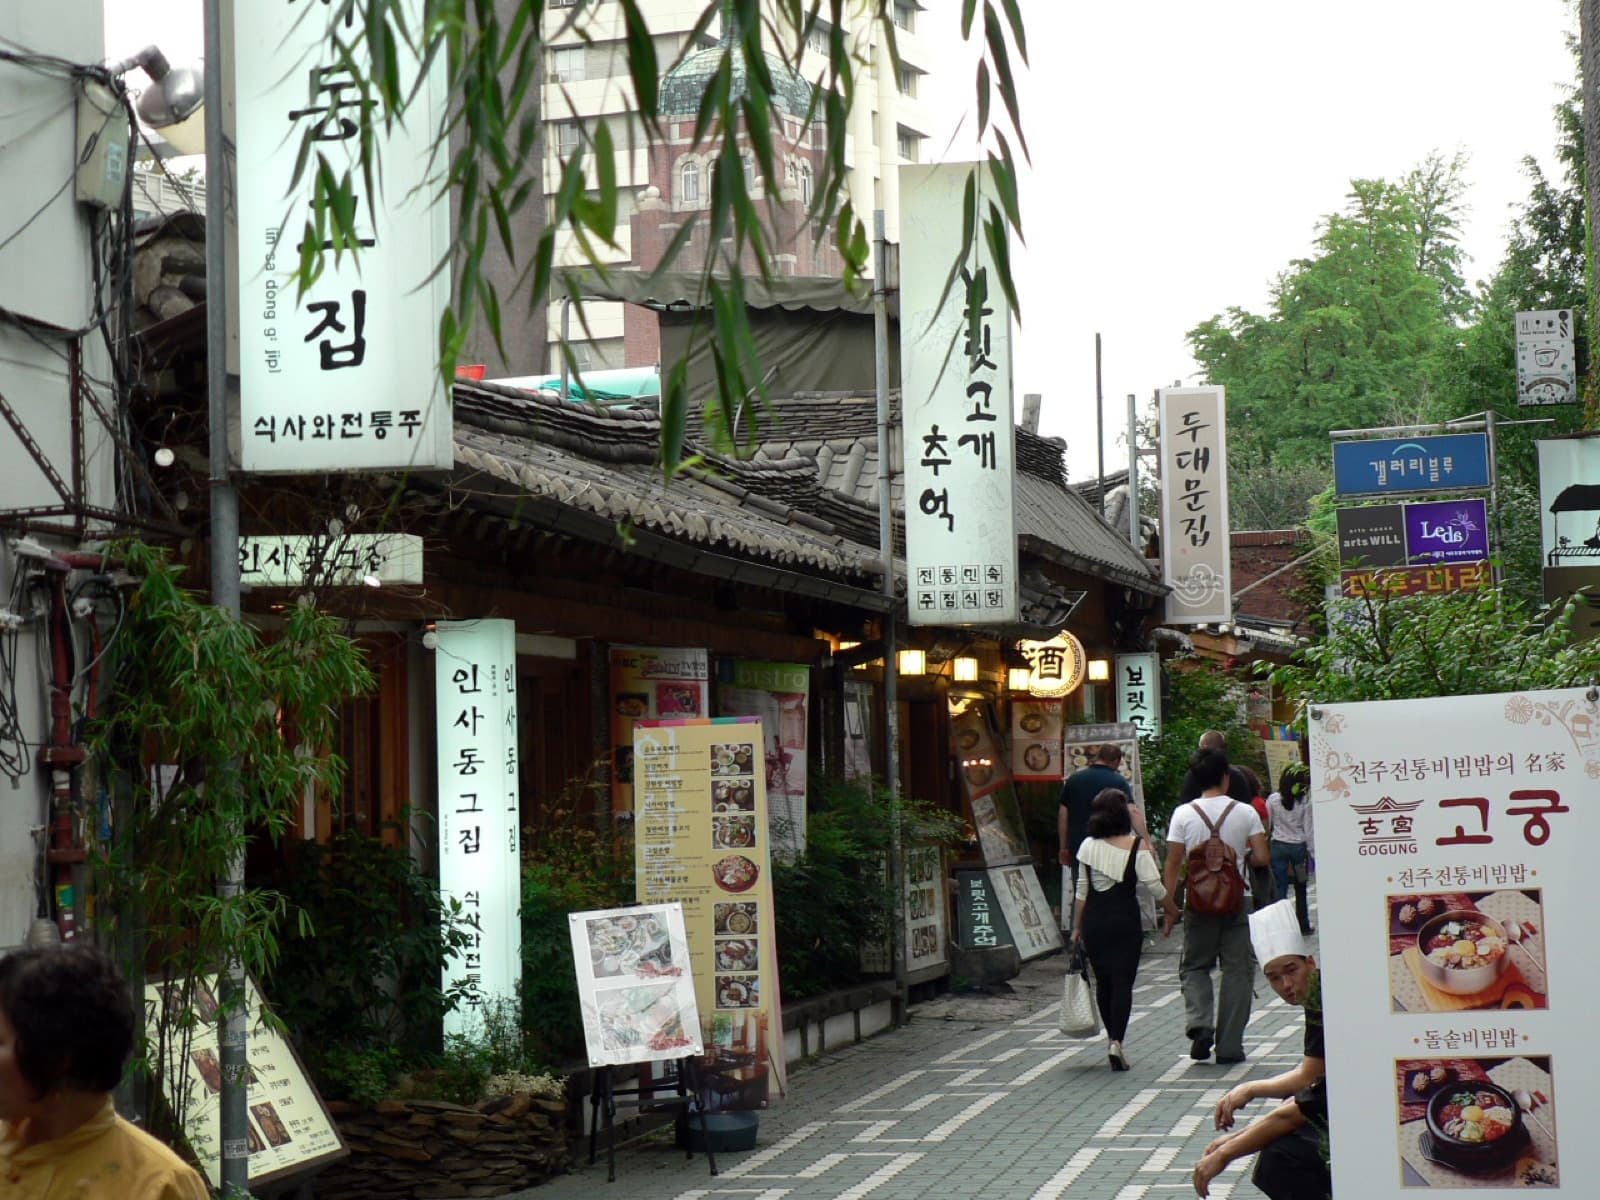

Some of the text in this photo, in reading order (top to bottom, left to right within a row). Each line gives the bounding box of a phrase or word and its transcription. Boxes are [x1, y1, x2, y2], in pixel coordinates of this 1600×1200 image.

[263, 279, 280, 320] dong
[253, 410, 424, 443] 식사와전통주
[919, 424, 955, 532] 추억
[1175, 411, 1211, 547] 두대문집
[1369, 456, 1454, 486] 갤러리블루
[1420, 521, 1463, 544] Leda
[452, 664, 485, 854] 인사동그집
[1348, 751, 1567, 785] 전주전통비빔밥의 名家
[1435, 789, 1570, 847] 고궁
[1358, 843, 1418, 856] GOGUNG
[1398, 864, 1529, 888] 전주전통비빔밥
[1423, 1027, 1519, 1050] 돌솥비빔밥
